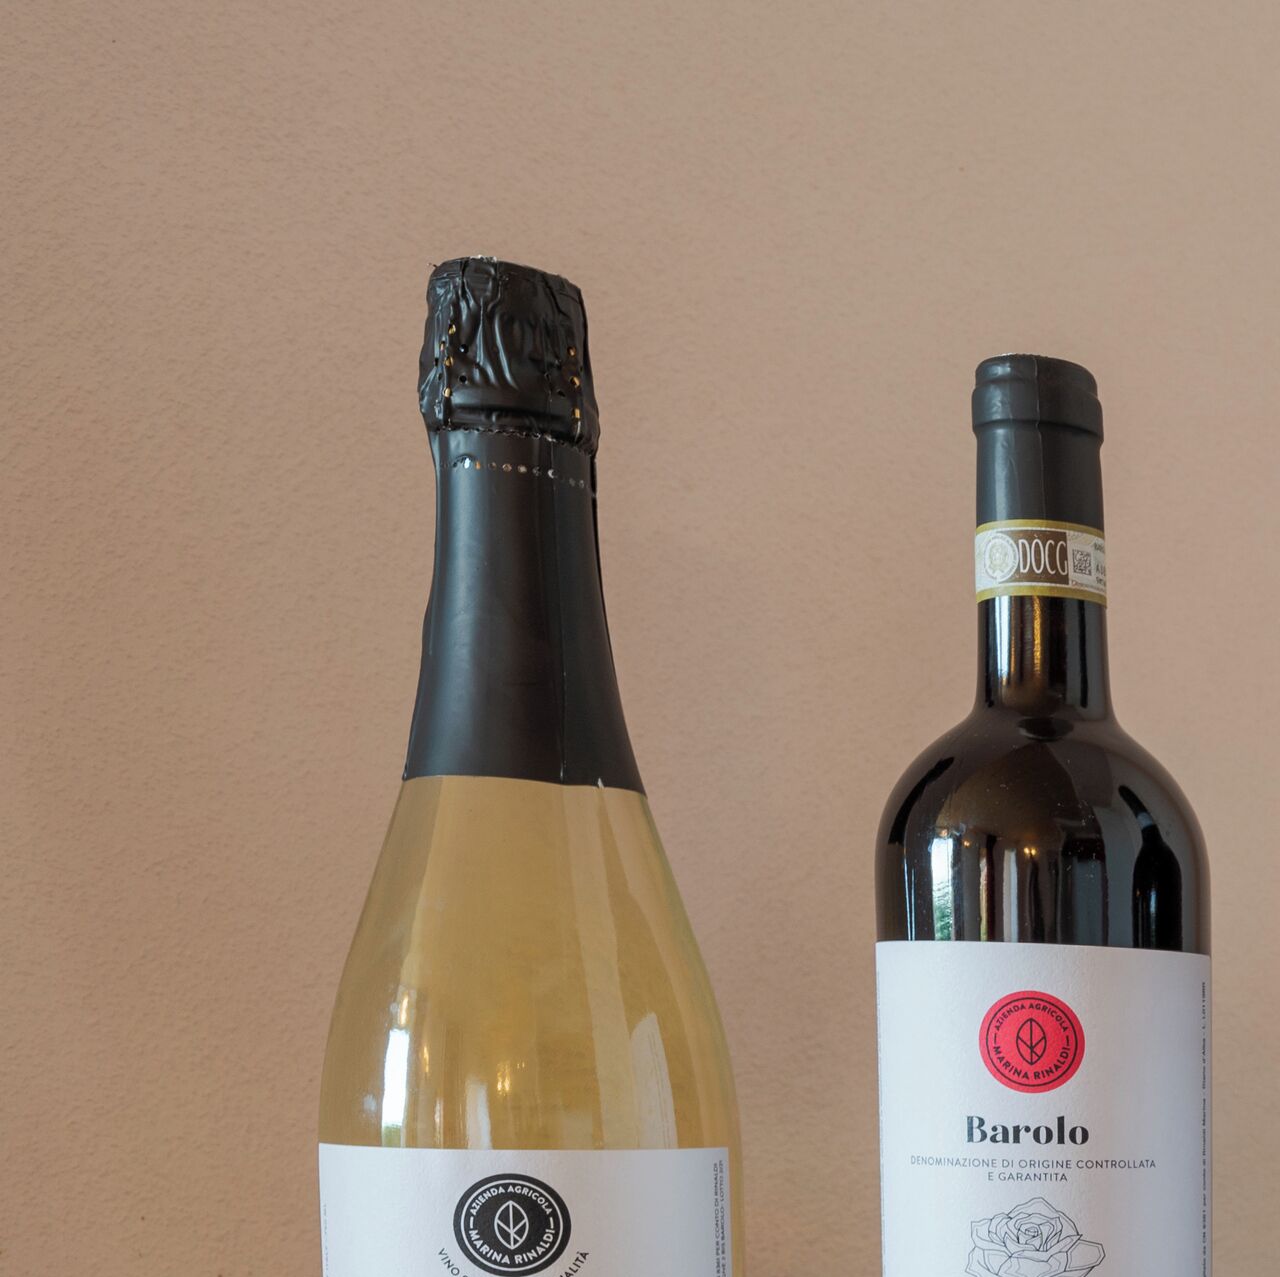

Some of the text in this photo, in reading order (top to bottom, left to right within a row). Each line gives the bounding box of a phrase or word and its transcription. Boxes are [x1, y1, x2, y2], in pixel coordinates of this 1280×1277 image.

[995, 1003, 1069, 1032] AZIENDA AGRICOLA
[993, 1046, 1070, 1080] MARINA RINALDI
[966, 1115, 1090, 1145] Barolo
[910, 1155, 1156, 1169] DENOMINAZIONE DI ORIGINE CONTROLLATA
[987, 1172, 1068, 1182] E GARANTITA
[469, 1185, 553, 1216] AZIENDA AGRICOLA
[469, 1228, 555, 1265] MARINA RINALDI
[438, 1248, 460, 1276] VINO
